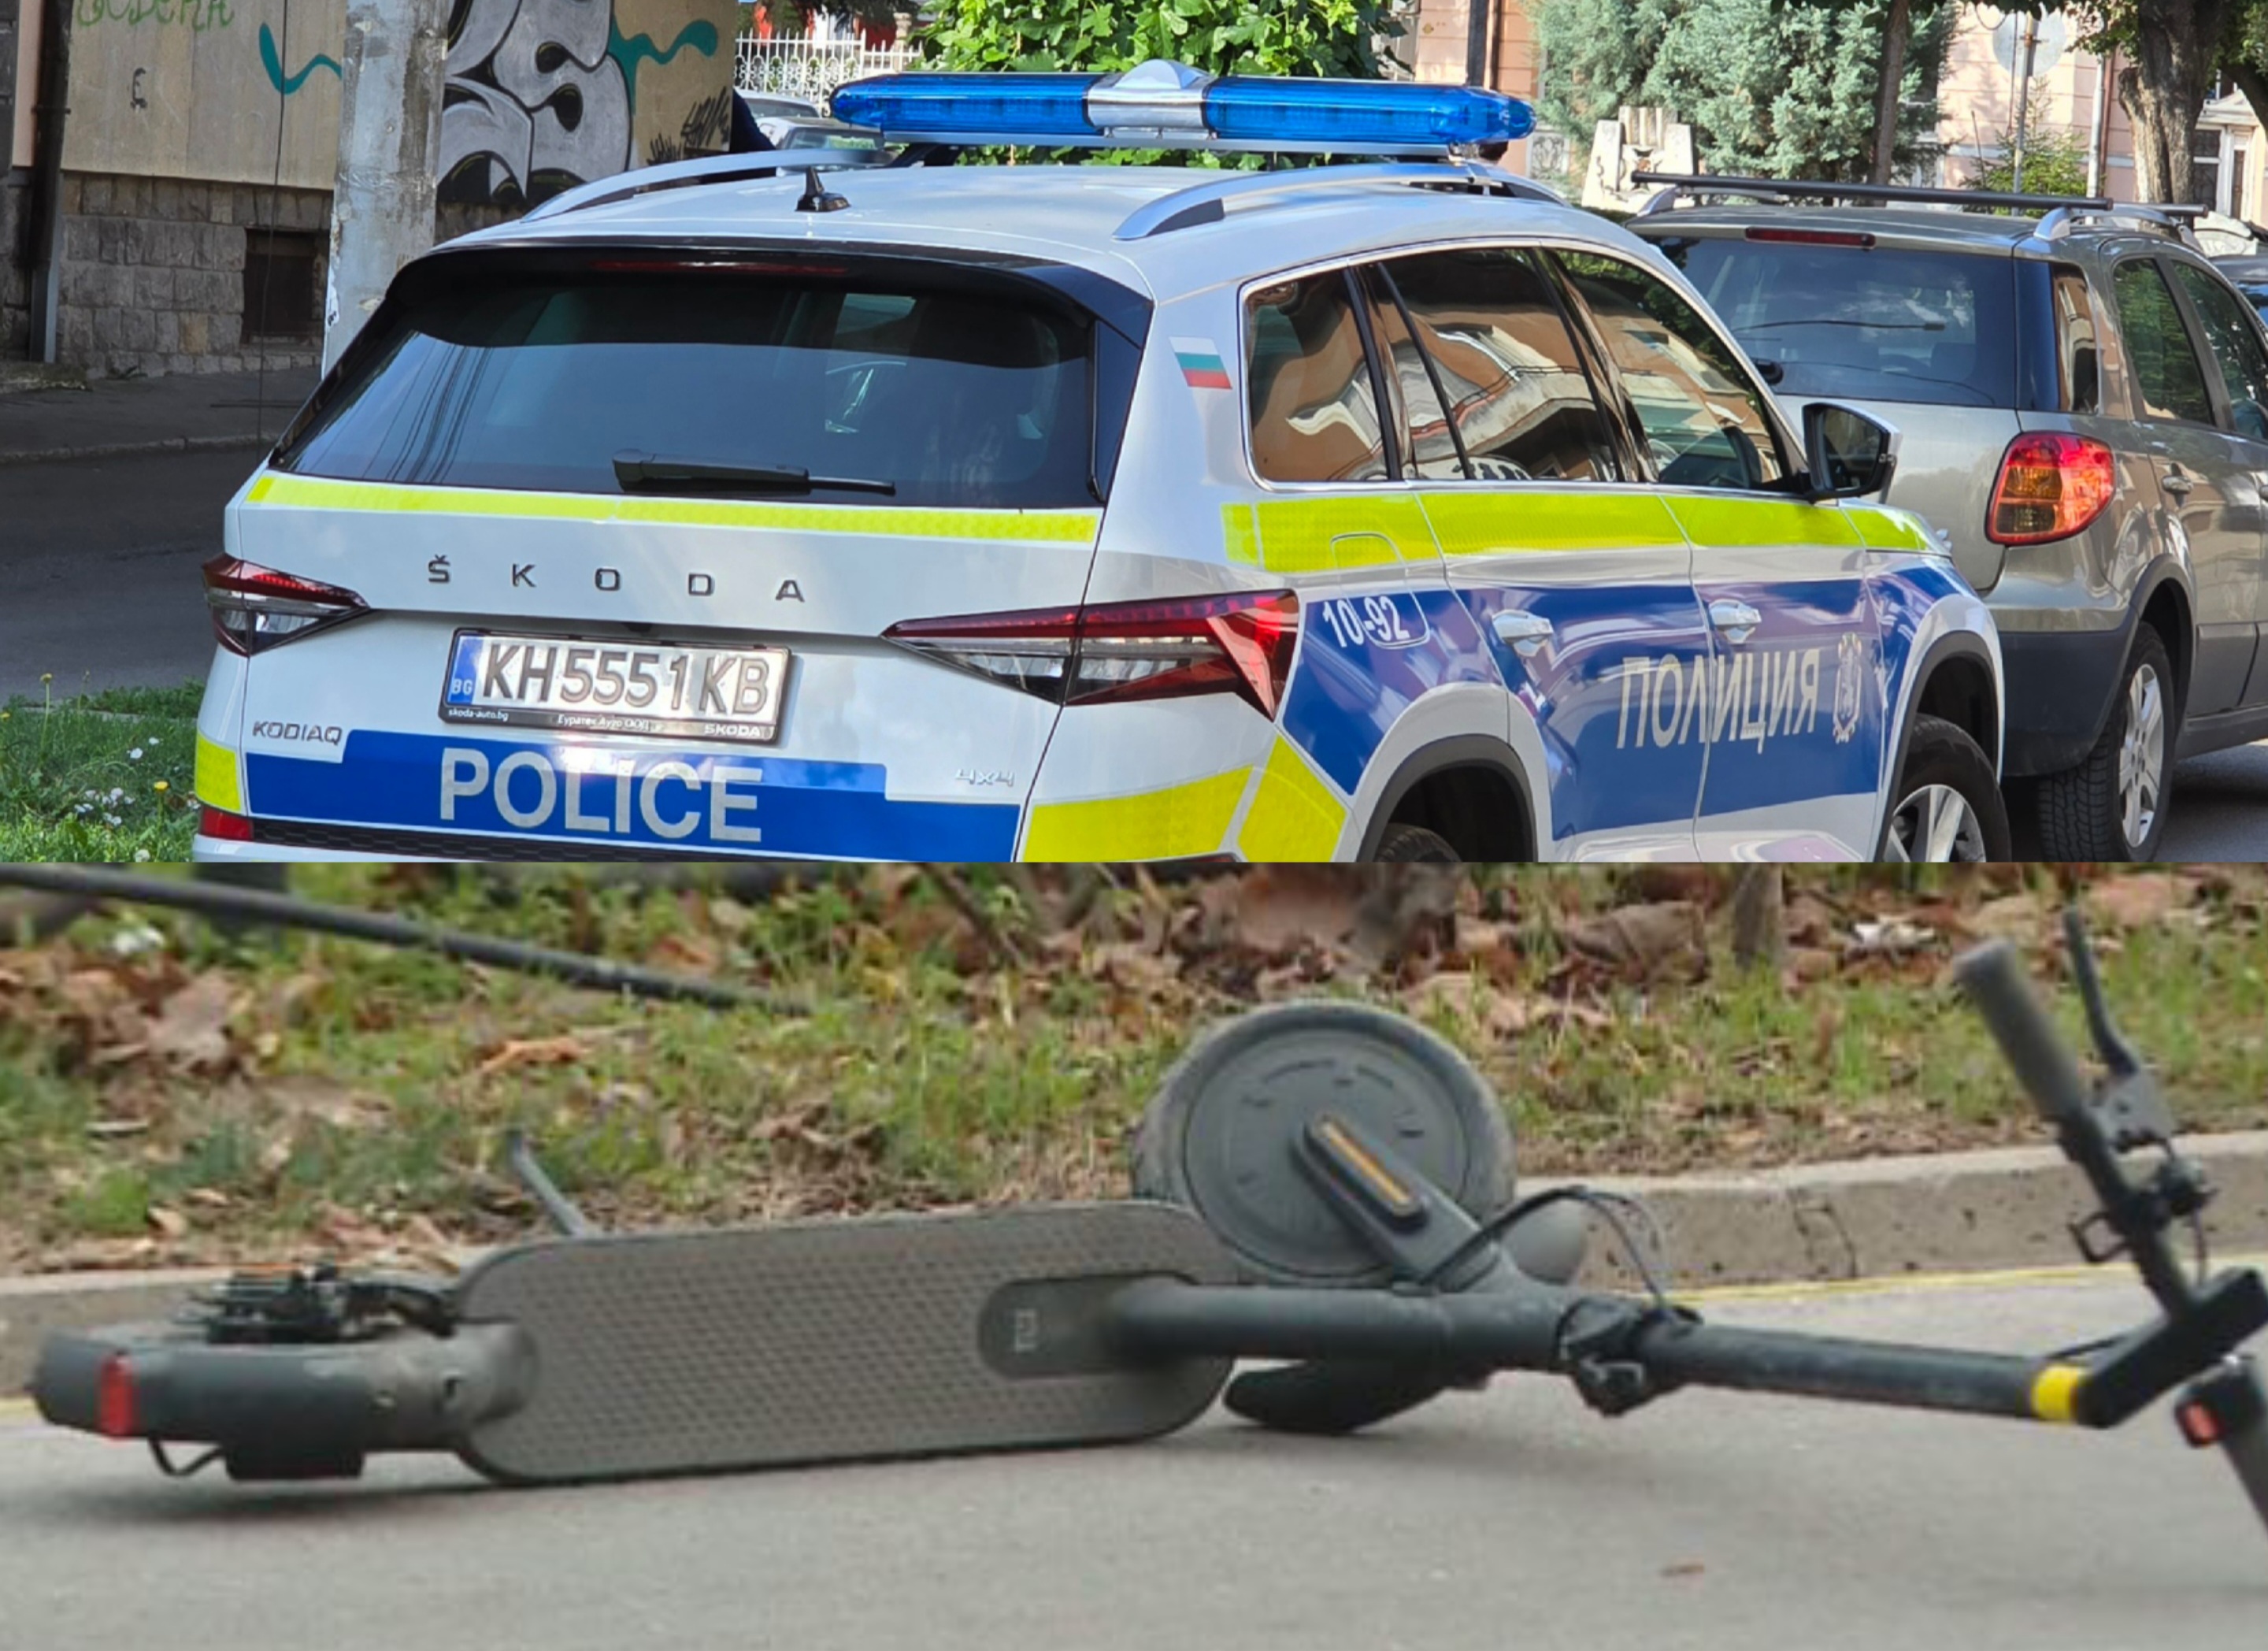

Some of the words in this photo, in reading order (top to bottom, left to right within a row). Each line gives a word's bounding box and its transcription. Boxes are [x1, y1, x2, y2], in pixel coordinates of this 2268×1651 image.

[428, 555, 805, 603] ŠKODA
[1322, 595, 1410, 647] 10-92
[451, 678, 473, 696] BG
[1616, 647, 1821, 755] ПОЛИЦИЯ
[253, 721, 343, 746] KODIAQ
[448, 707, 510, 722] skoda-auto.bg
[439, 747, 764, 843] POLICE
